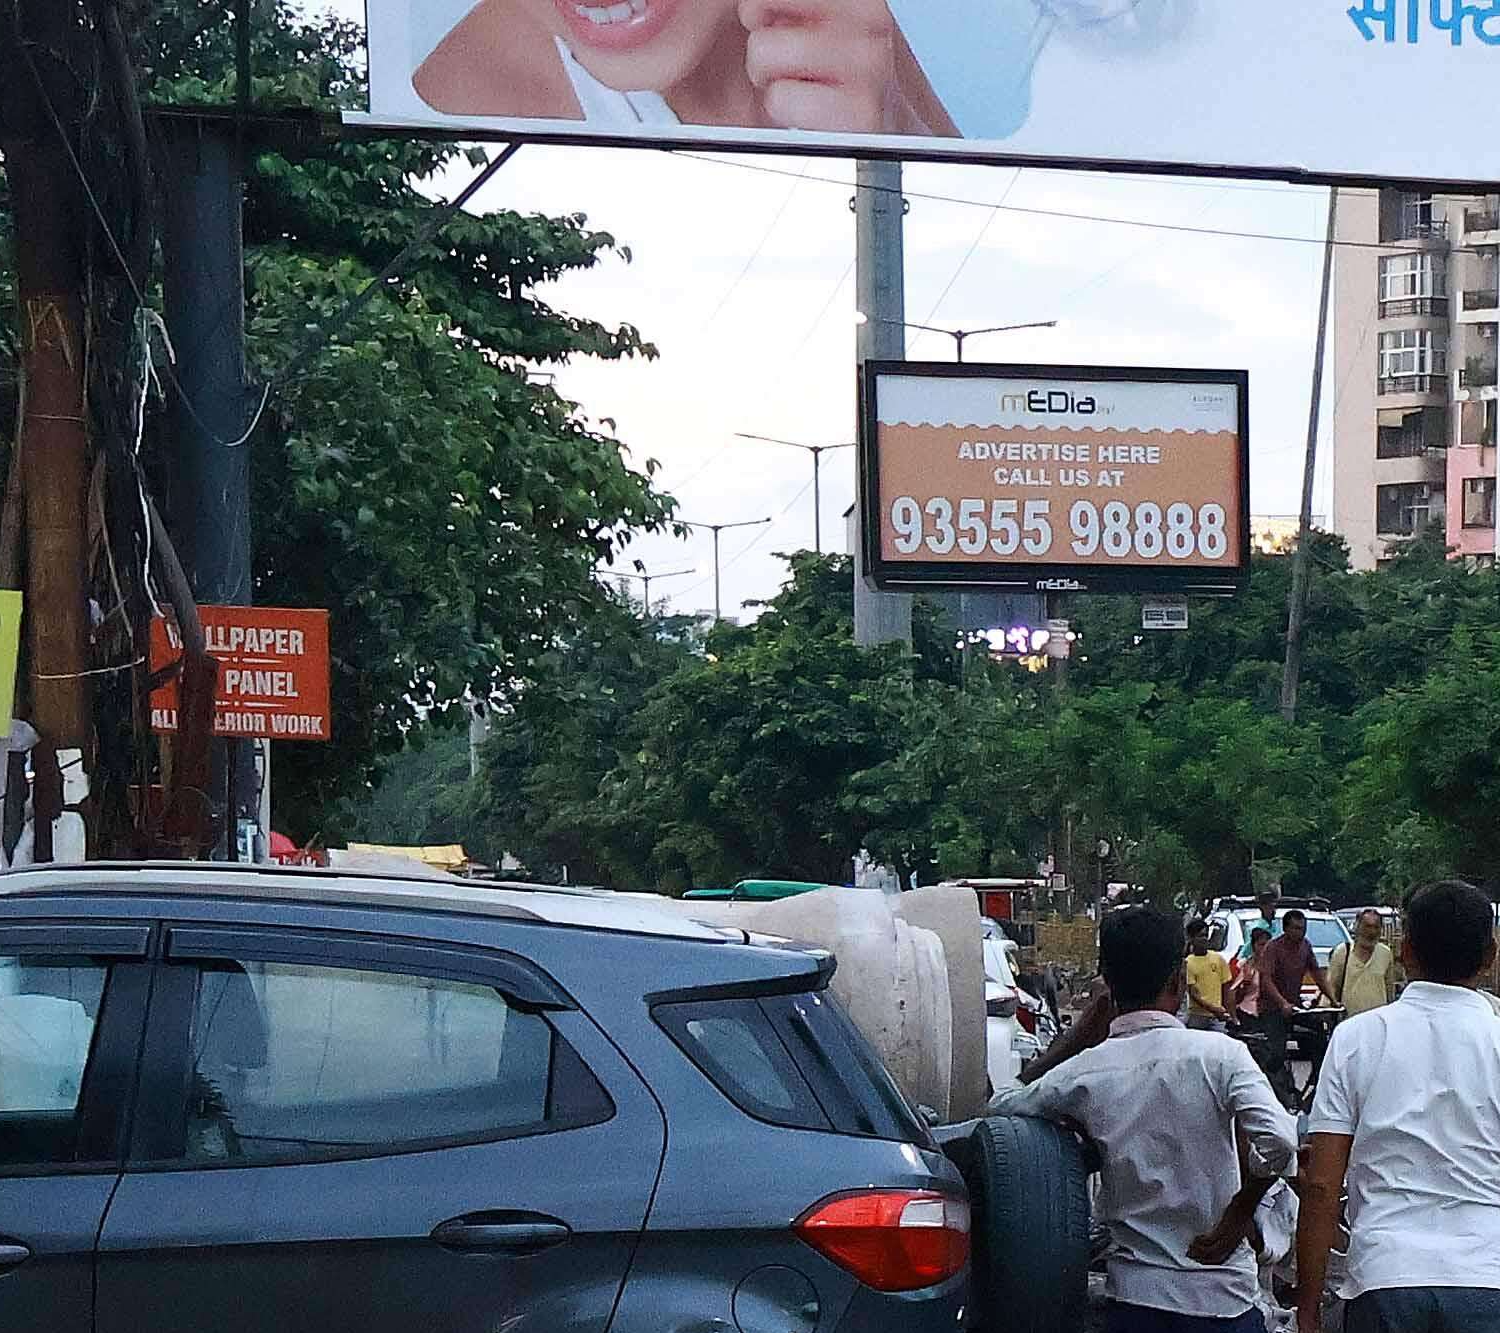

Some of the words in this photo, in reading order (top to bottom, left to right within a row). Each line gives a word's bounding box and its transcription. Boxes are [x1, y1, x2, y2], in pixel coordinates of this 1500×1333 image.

[957, 440, 1090, 464] ADVERTISE
[1098, 444, 1161, 465] HERE
[993, 467, 1051, 487] CALL
[1059, 468, 1090, 487] US
[1097, 469, 1125, 488] AT
[890, 496, 1053, 556] 93555
[1069, 500, 1228, 560] 98888
[225, 669, 299, 698] PANEL
[271, 714, 323, 735] WORK
